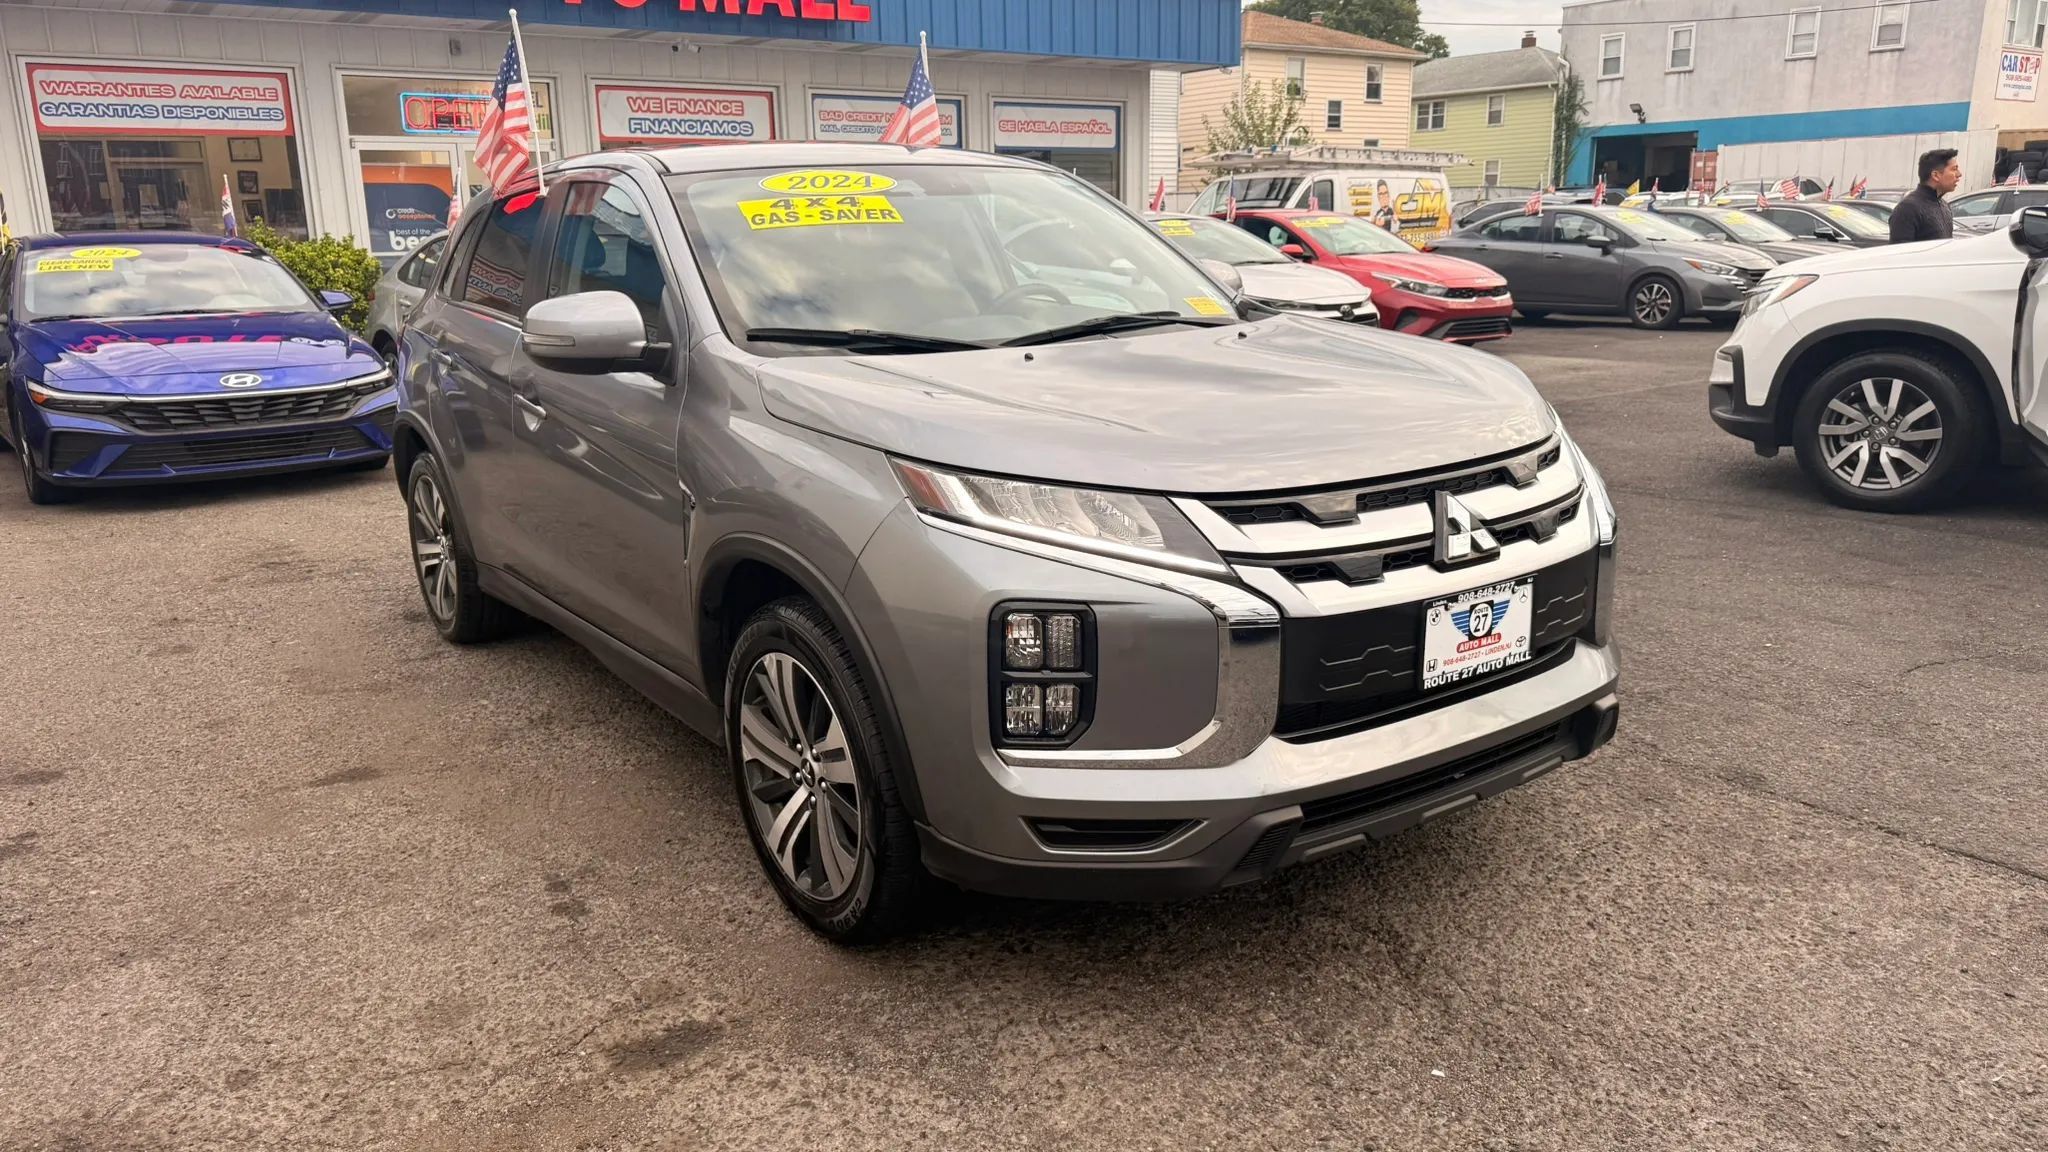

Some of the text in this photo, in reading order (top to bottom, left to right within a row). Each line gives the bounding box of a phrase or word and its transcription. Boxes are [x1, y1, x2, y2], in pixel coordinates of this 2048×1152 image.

[2002, 54, 2019, 72] CAR
[40, 81, 278, 101] WARRANTIES AVAILABLE
[39, 102, 285, 121] GARANTIAS DISPONIBLES
[627, 97, 744, 116] WE FINANCE
[820, 111, 844, 121] BAD
[845, 113, 882, 122] CREDIT
[628, 117, 753, 136] FINANCIAMOS
[820, 124, 840, 133] MAL
[840, 125, 876, 134] CREDITO
[999, 119, 1112, 134] SE HABLA ESPAÑOL
[788, 174, 873, 190] 2024
[769, 198, 797, 210] 4
[836, 196, 863, 208] 4
[750, 211, 800, 226] GAS
[819, 208, 897, 221] SAVER
[389, 230, 425, 251] be
[1458, 581, 1515, 603] 908-648-2727
[1474, 607, 1489, 615] ROUTE
[1474, 613, 1489, 633] 27
[1459, 634, 1501, 652] AUTO MALL
[1443, 652, 1480, 667] 908-648-2727
[1424, 651, 1532, 689] ROUTE 27 AUTO MALL
